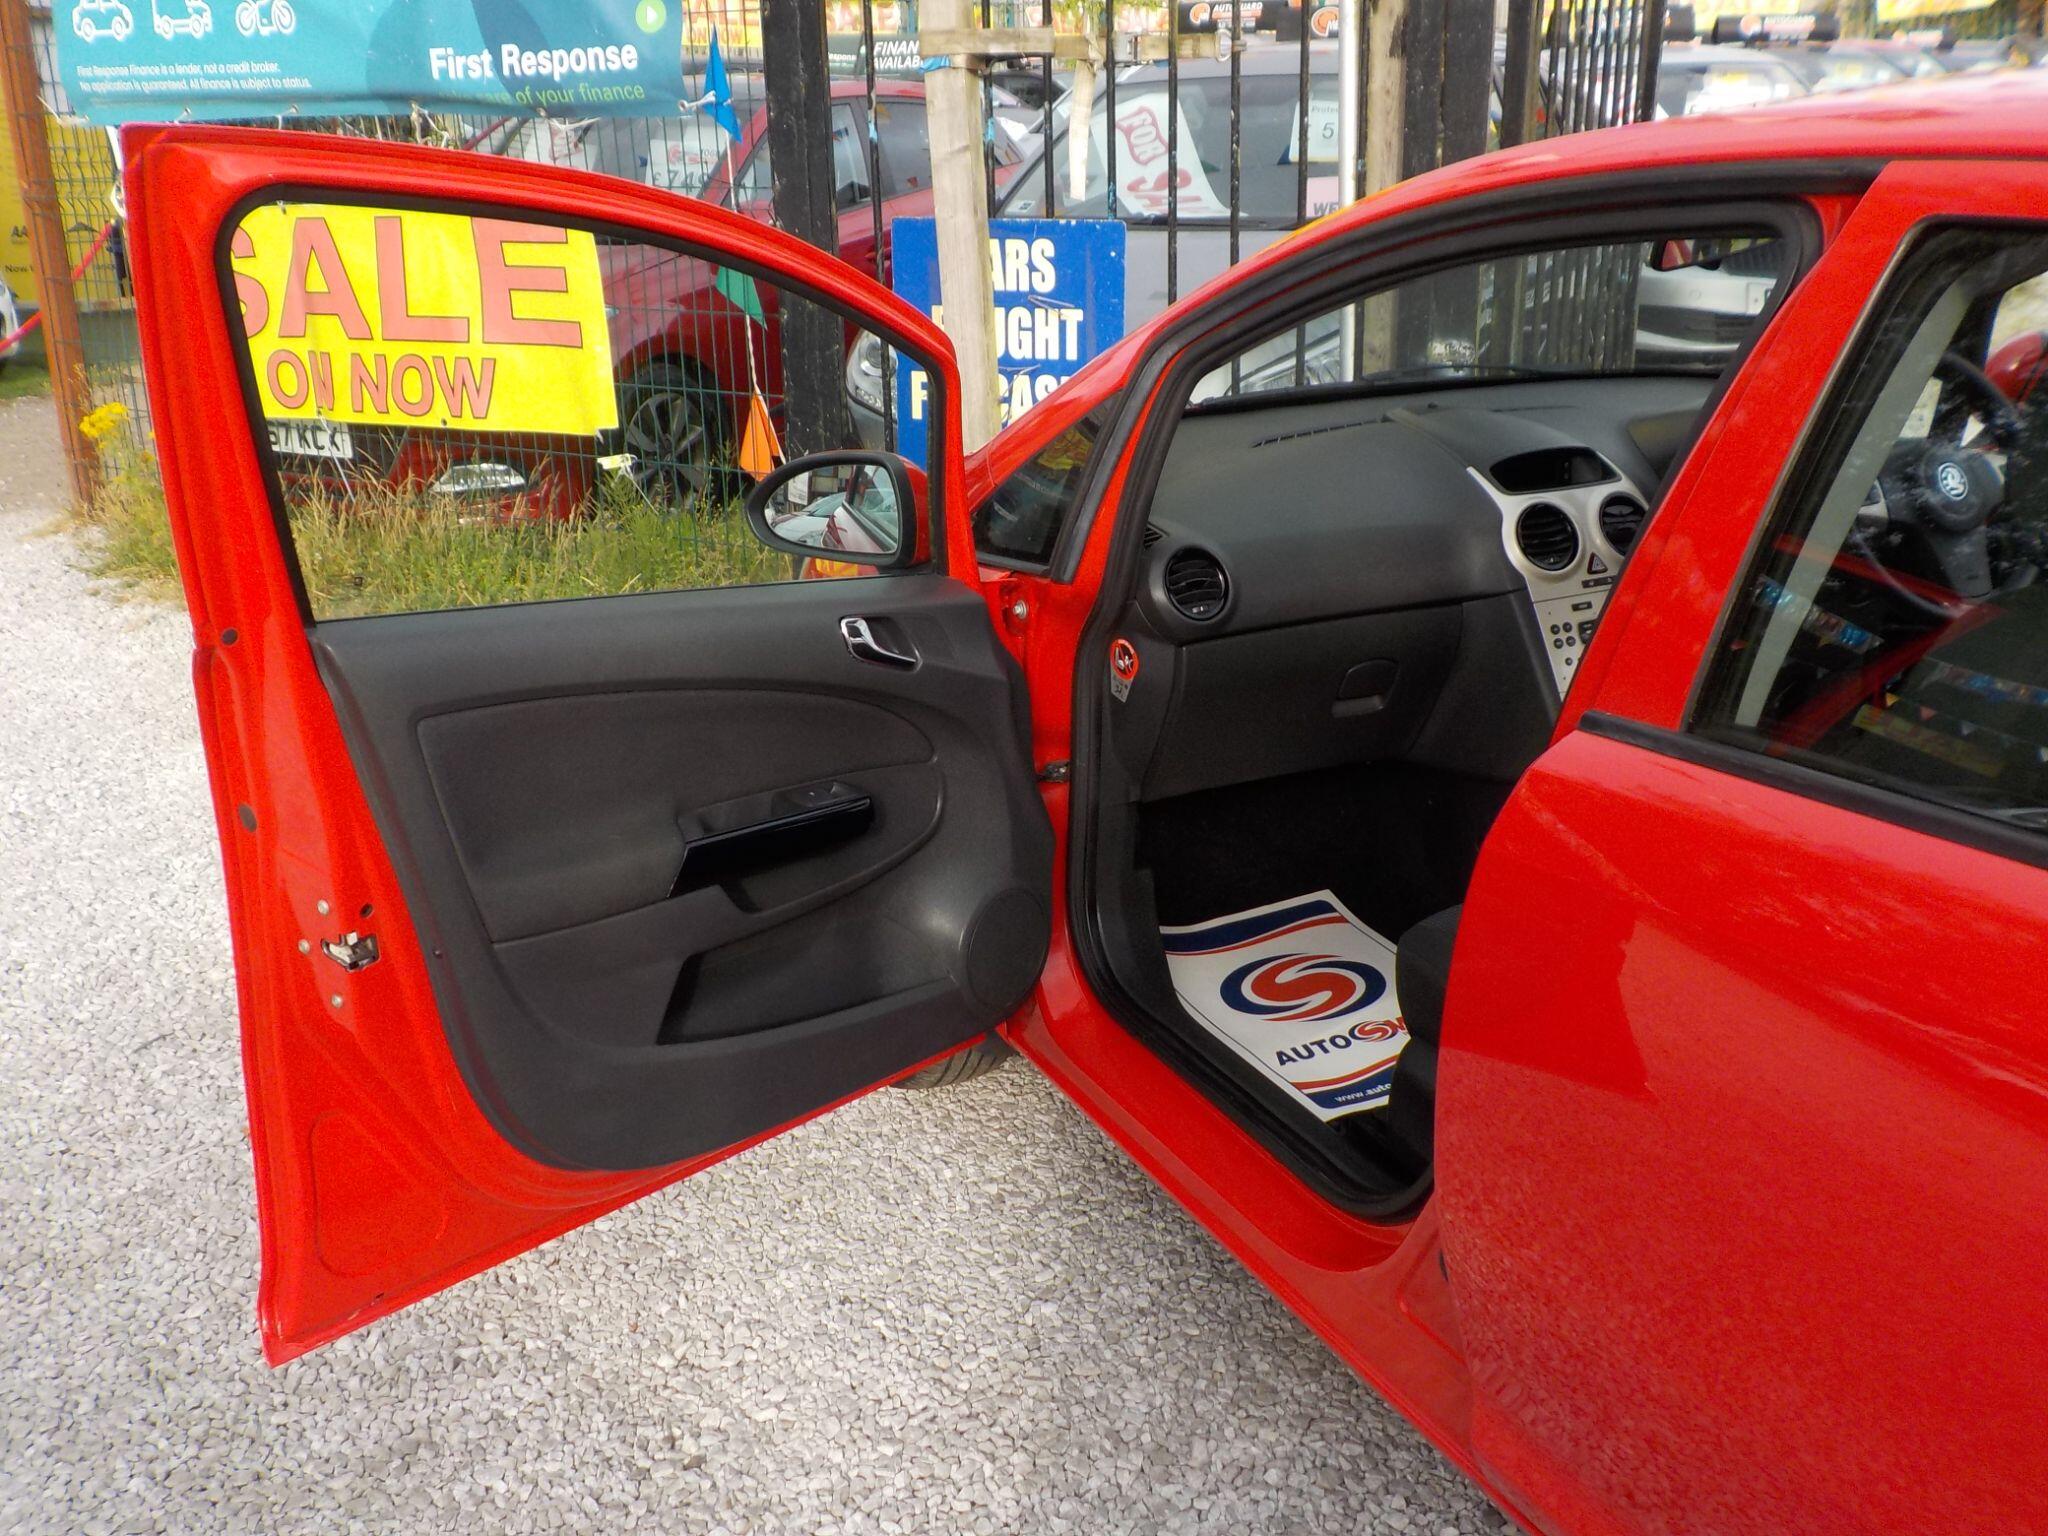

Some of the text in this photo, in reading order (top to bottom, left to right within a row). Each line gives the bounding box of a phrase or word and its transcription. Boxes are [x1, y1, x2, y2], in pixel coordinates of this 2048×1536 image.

[1214, 2, 1263, 12] AUTOUARD
[873, 40, 920, 56] FINAN
[129, 64, 160, 76] Finance
[204, 64, 218, 74] not
[226, 61, 250, 74] credit
[250, 60, 281, 73] broker.
[429, 43, 639, 82] First Response
[873, 55, 922, 70] AVAILAB
[91, 80, 135, 93] application
[200, 77, 231, 90] finance
[240, 76, 271, 91] subject
[271, 77, 281, 88] to
[282, 75, 312, 88] status.
[515, 85, 531, 106] of
[535, 88, 575, 107] your
[579, 81, 646, 102] finance
[989, 238, 1057, 293] ARS
[267, 349, 497, 420] ON NOW
[1335, 1083, 1392, 1103] www.auto
